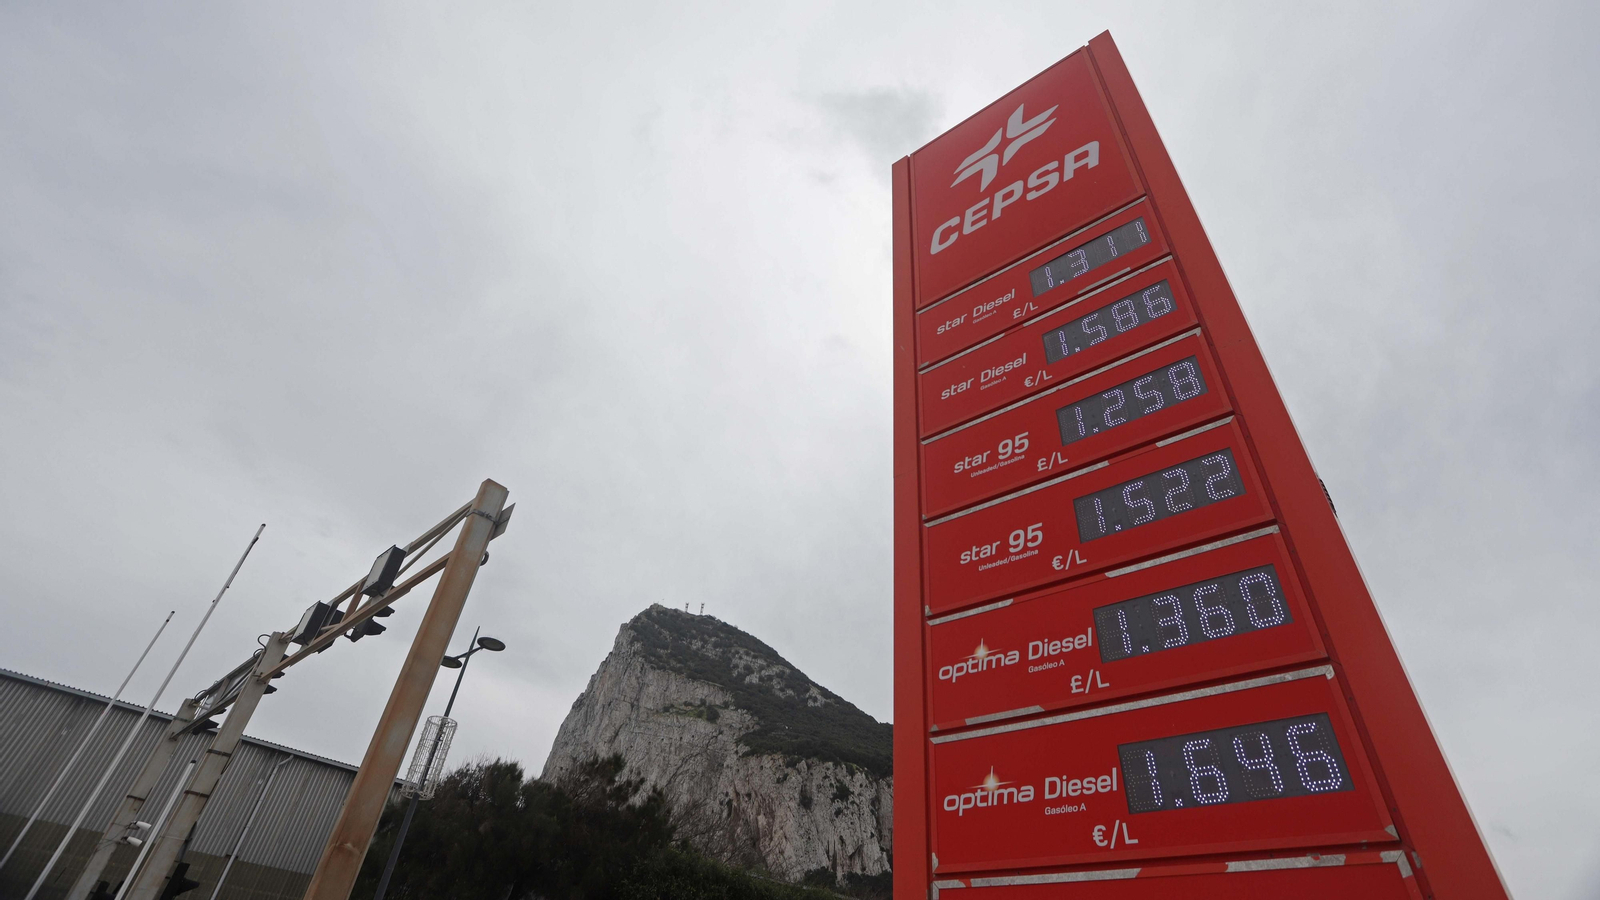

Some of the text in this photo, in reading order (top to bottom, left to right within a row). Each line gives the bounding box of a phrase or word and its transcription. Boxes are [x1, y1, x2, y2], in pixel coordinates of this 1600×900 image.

[930, 140, 1100, 255] CEPSA
[1045, 221, 1147, 288] 1.311
[936, 288, 1016, 335] star Diesel
[1012, 302, 1039, 320] £/L
[1059, 285, 1171, 356] 1.586
[941, 352, 1027, 400] star Diesel
[1024, 370, 1053, 388] €/L
[1074, 361, 1201, 436] 1.258
[953, 431, 1030, 474] star 95
[970, 454, 1025, 478] Unleaded/Gasolina
[1037, 452, 1068, 472] £/L
[1094, 454, 1236, 534] 1.522
[960, 522, 1044, 565] star 95
[978, 548, 1039, 572] Unleaded/Gasolina
[1051, 549, 1087, 571] €/L
[1117, 572, 1285, 655] 1.360
[938, 627, 1093, 683] optima Diesel
[1028, 659, 1065, 674] Gasóleo A
[1070, 669, 1110, 694] £/L
[1145, 722, 1343, 807] 1.646
[943, 767, 1118, 816] optima Diesel
[1044, 804, 1086, 816] Gasóleo A
[1092, 820, 1139, 849] €/L
